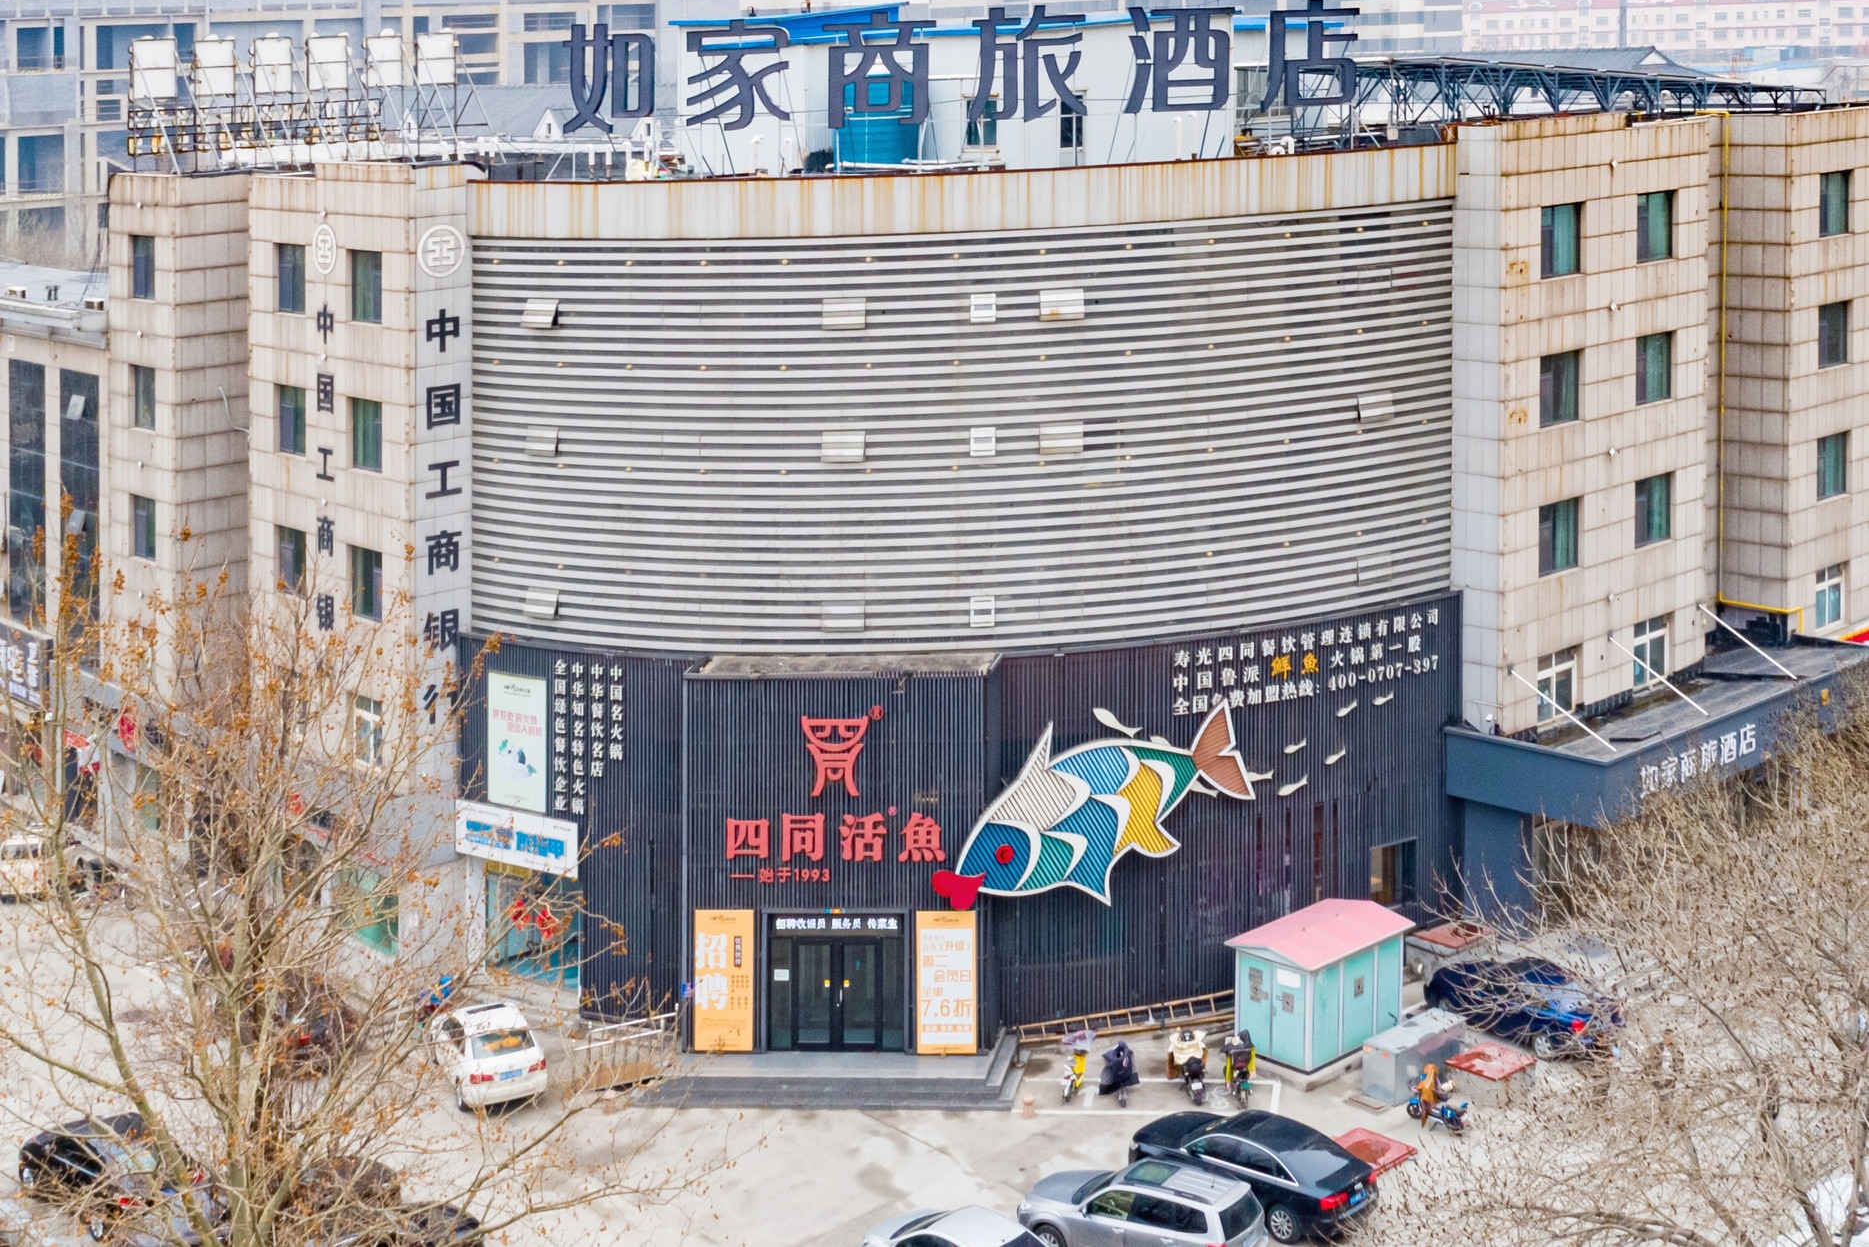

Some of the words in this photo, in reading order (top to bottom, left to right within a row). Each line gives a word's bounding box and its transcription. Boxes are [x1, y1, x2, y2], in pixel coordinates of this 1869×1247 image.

[563, 0, 1360, 134] 如家商旅酒店
[316, 303, 335, 639] 中国工商银
[1173, 608, 1439, 668] 寿光四同餐饮管理连锁有限公司
[554, 659, 568, 811] 全国绿色餐饮企业
[571, 662, 585, 815] 中华知名特色火锅
[590, 663, 604, 777] 中华餐饮名店
[610, 665, 624, 761] 中国名火锅
[695, 932, 728, 1011] 招聘
[831, 918, 861, 930] 服务员
[867, 918, 898, 930] 传菜生
[921, 998, 971, 1017] 7.6折
[934, 969, 972, 982] 会员日
